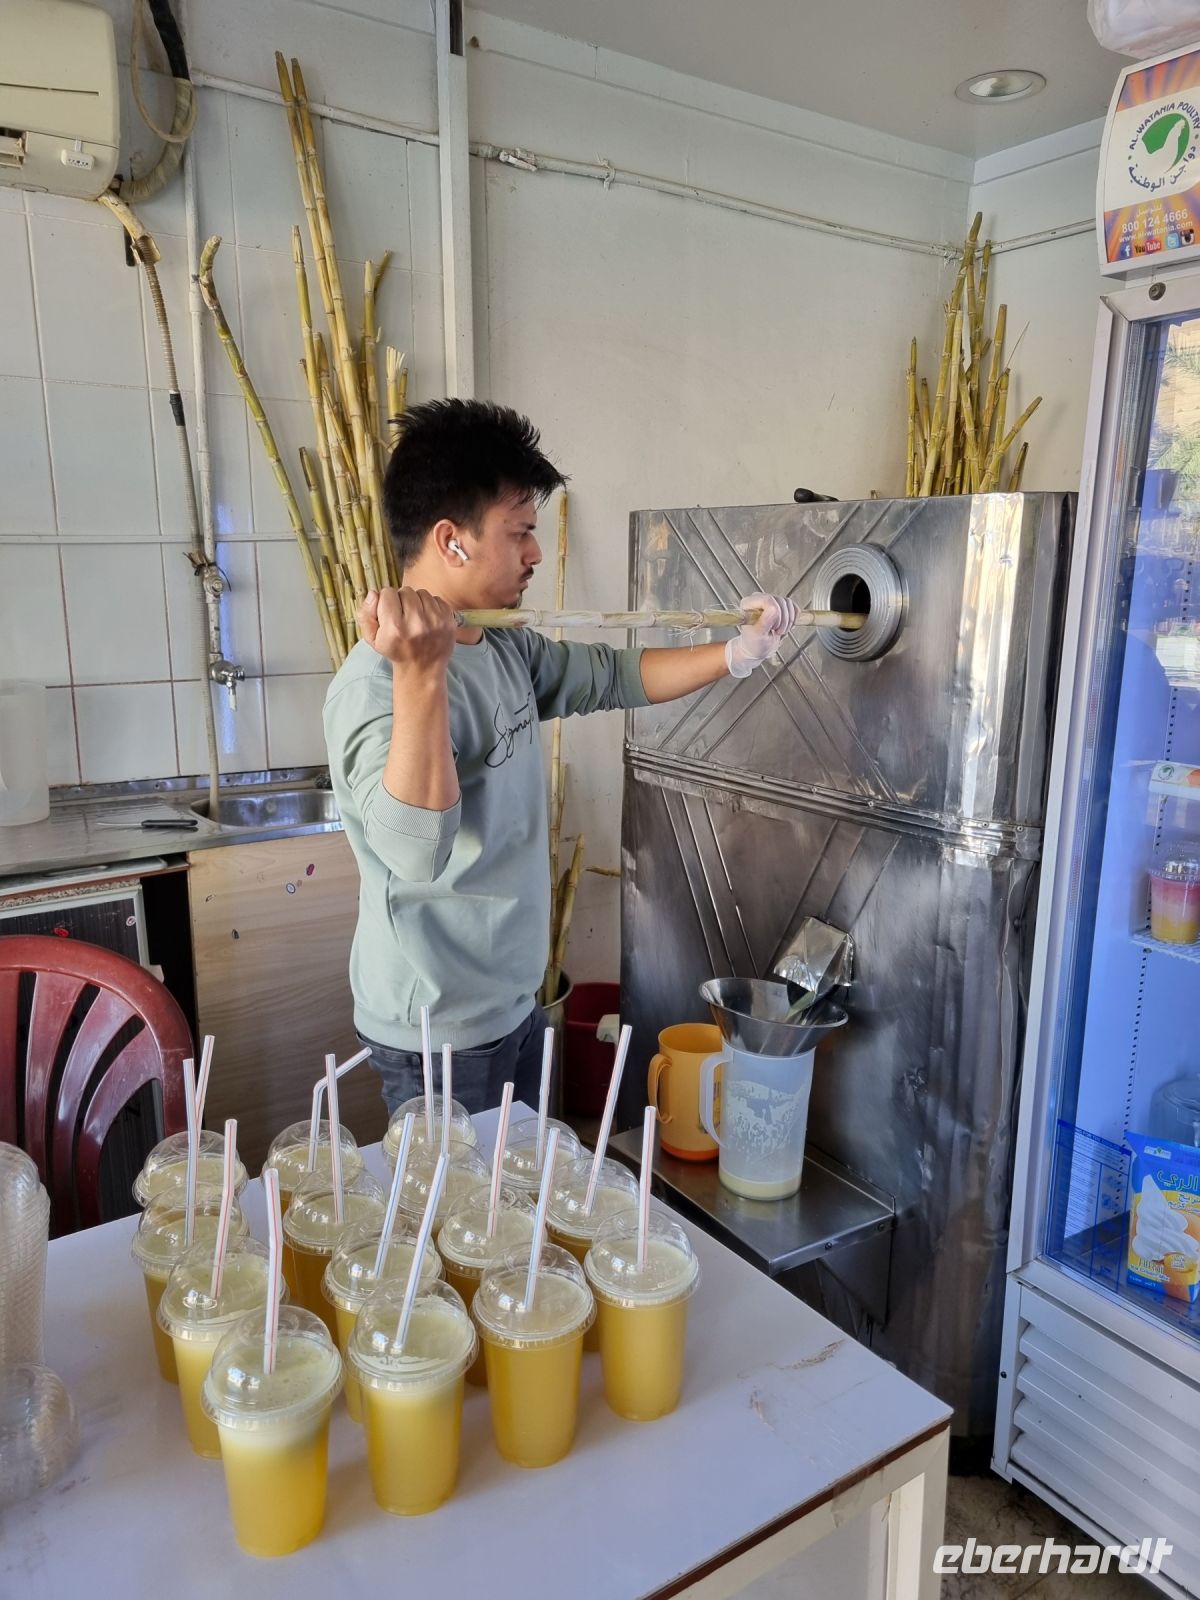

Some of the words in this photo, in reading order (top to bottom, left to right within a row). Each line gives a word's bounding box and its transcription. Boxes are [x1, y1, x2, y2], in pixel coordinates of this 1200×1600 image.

[1129, 103, 1175, 150] AL-WATANIA
[1177, 101, 1200, 129] POULTRY
[1170, 146, 1196, 184] دواجن
[1122, 221, 1139, 234] 800
[1143, 215, 1161, 228] 124
[1163, 208, 1188, 223] 4666
